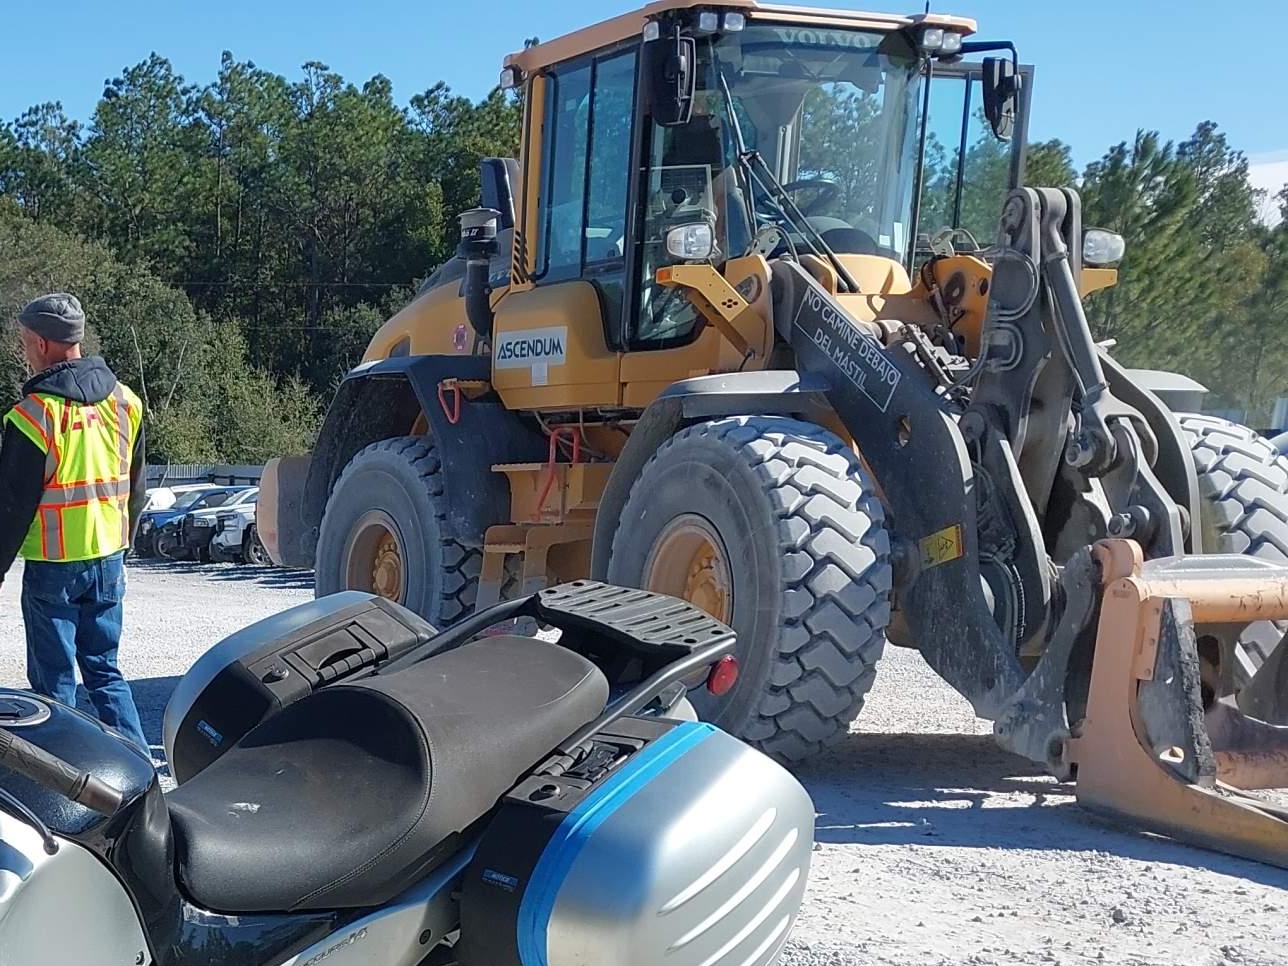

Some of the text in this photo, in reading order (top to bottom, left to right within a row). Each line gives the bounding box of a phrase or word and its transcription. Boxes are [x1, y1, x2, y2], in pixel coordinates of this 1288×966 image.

[773, 28, 873, 48] VOLVO
[497, 336, 564, 361] ASCENDUM
[804, 288, 898, 385] NO CAMINE DEBAJO
[813, 328, 868, 390] DEL MÁSTIL
